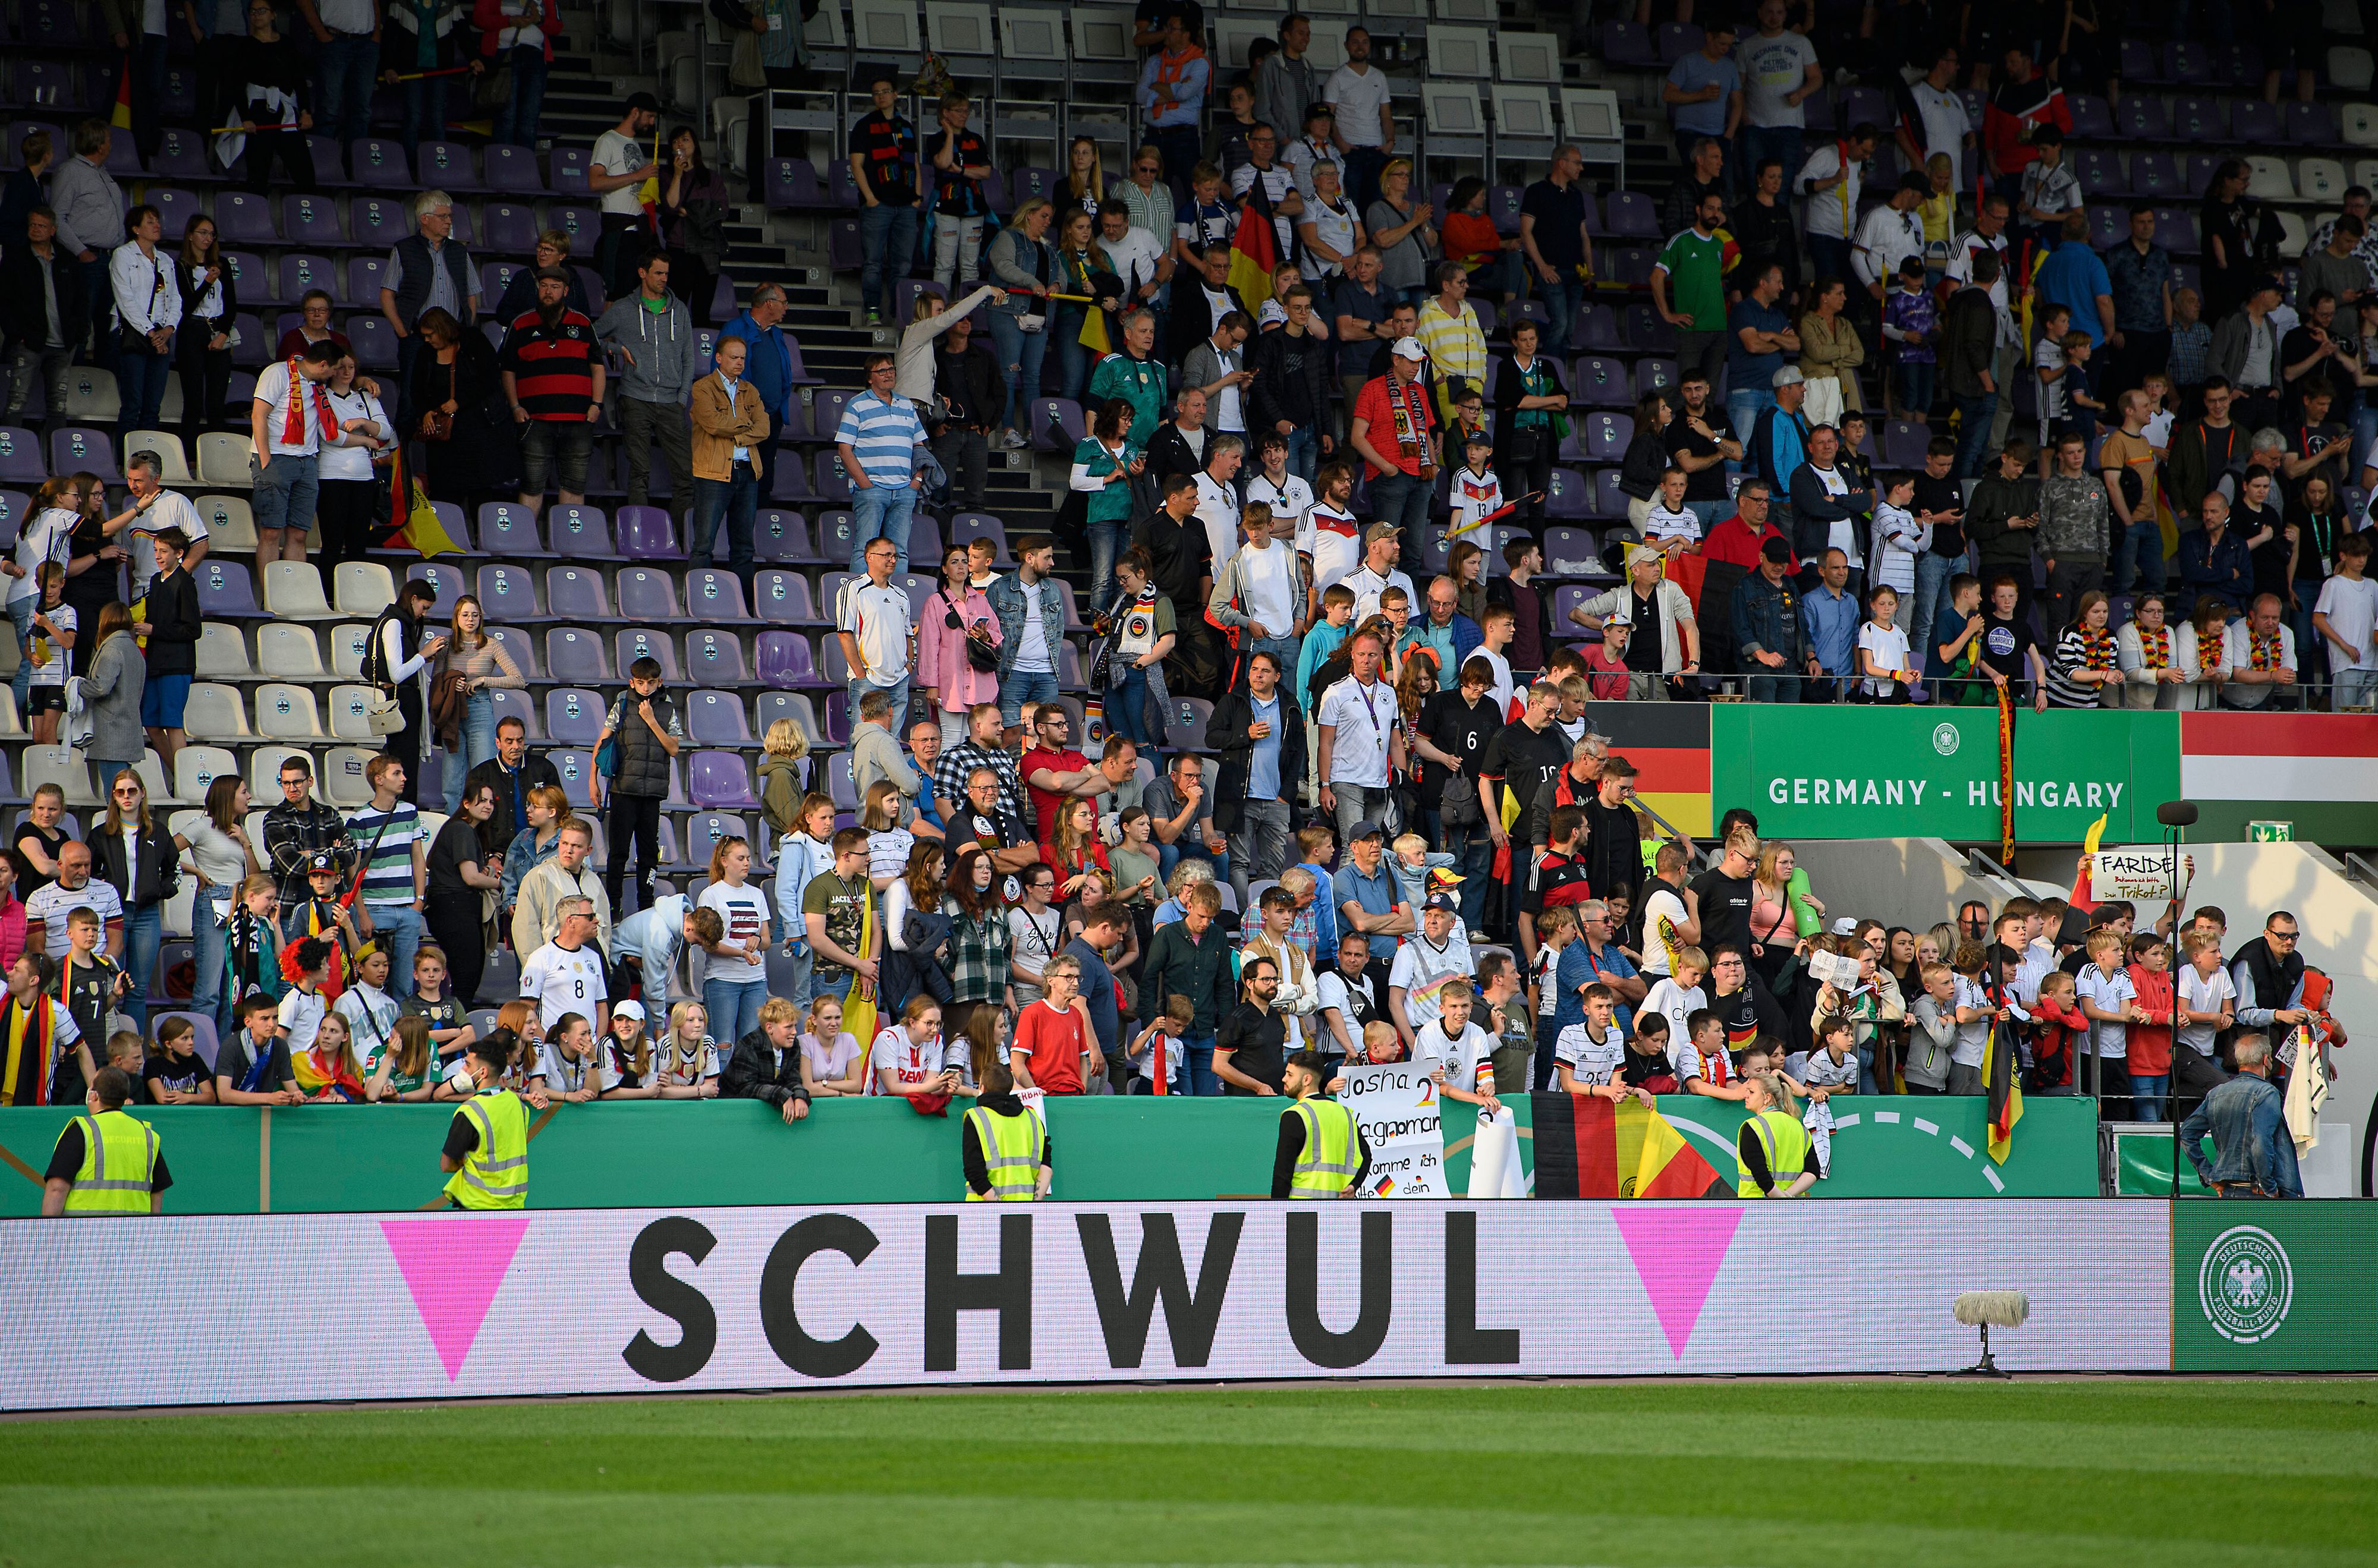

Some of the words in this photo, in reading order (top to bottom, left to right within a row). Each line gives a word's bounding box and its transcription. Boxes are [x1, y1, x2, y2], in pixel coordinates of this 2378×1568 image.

[1477, 503, 1486, 518] 13
[1467, 731, 1477, 750] 6
[1769, 778, 1926, 805] GERMANY
[1968, 780, 2123, 807] HUNGARY
[2102, 855, 2175, 874] FARIDE
[575, 980, 584, 999] 8
[90, 1000, 99, 1019] 7
[1341, 1069, 1410, 1099] Josha
[1586, 1072, 1603, 1087] 25
[103, 1134, 147, 1145] SECURITY
[1420, 1153, 1437, 1168] ich
[1403, 1180, 1430, 1196] dein
[2217, 1242, 2273, 1262] DEUTSCHER
[621, 1211, 1520, 1381] SCHWUL
